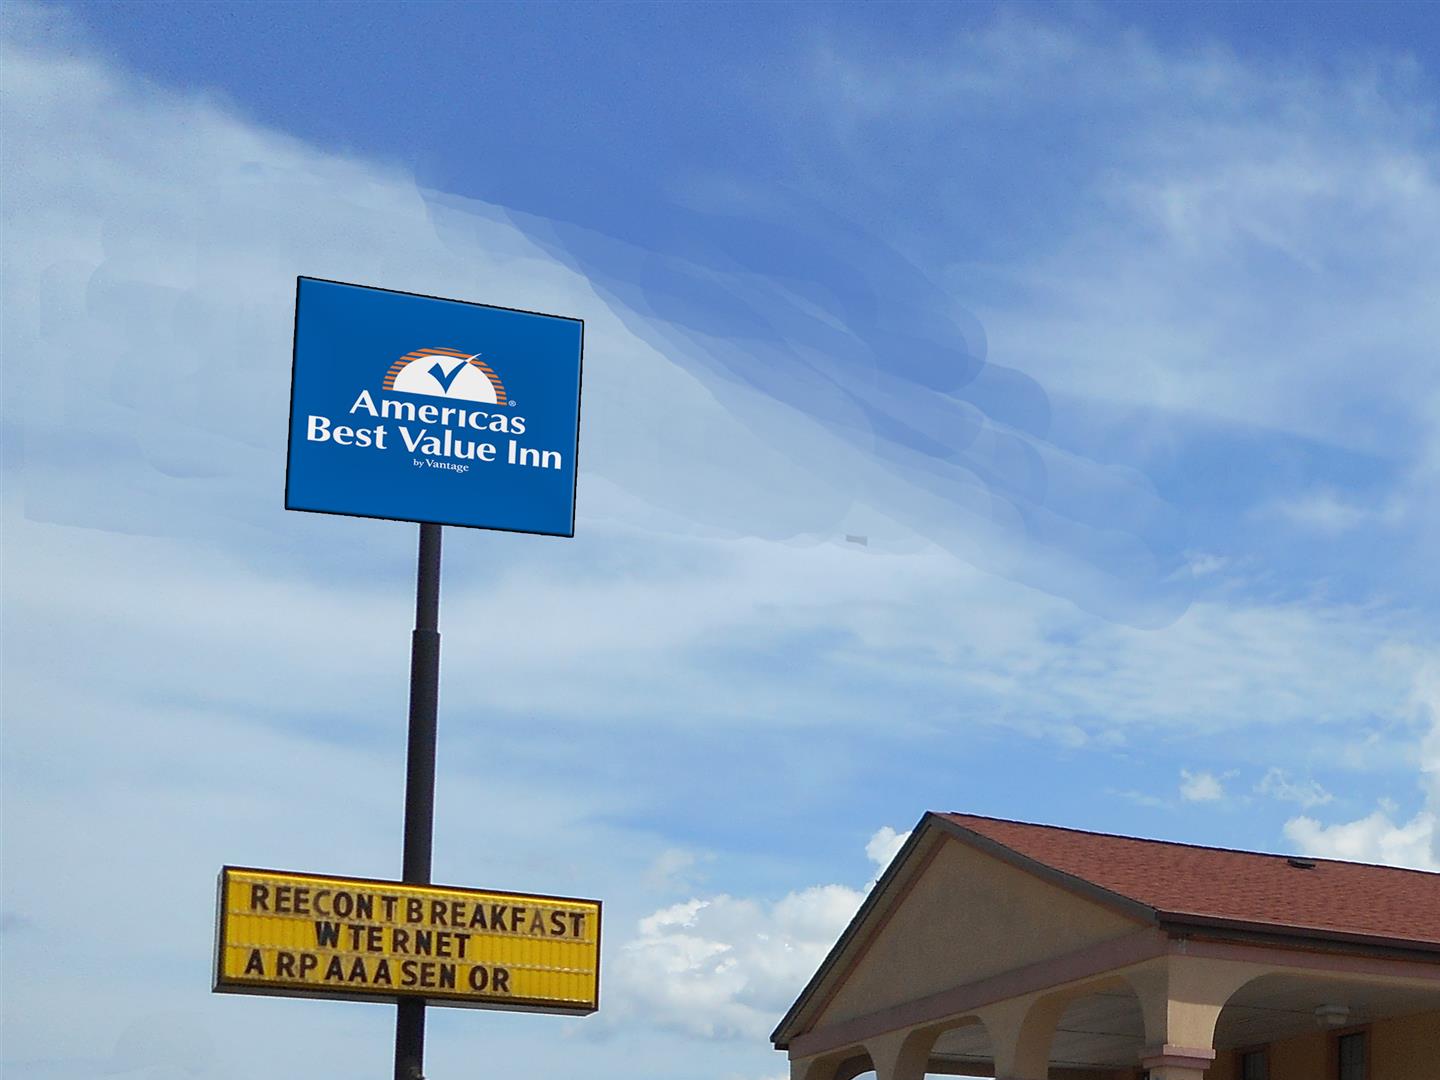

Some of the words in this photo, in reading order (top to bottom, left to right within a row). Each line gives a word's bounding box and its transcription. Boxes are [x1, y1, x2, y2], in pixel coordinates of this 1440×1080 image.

[350, 389, 526, 434] Americas
[307, 415, 387, 449] Best
[398, 426, 497, 461] Value
[508, 440, 562, 469] Inn
[413, 459, 424, 468] by
[425, 459, 469, 473] Vantage
